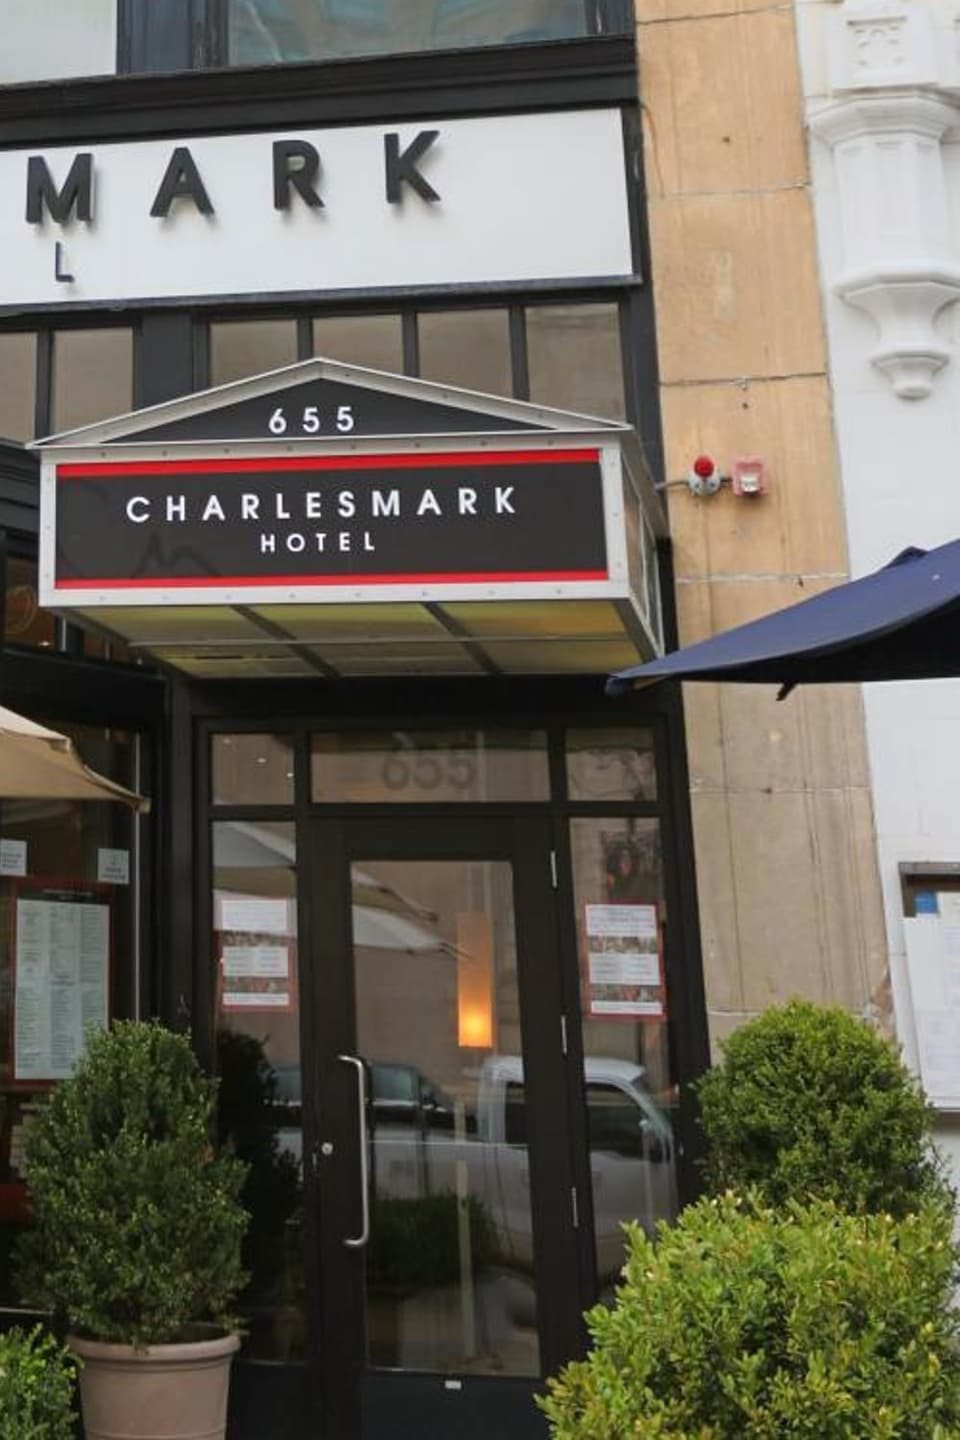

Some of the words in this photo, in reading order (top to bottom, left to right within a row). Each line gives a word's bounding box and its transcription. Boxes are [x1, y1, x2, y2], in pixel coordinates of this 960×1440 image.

[268, 406, 355, 434] 655
[126, 486, 517, 523] CHARLESMARK
[260, 531, 376, 553] HOTEL
